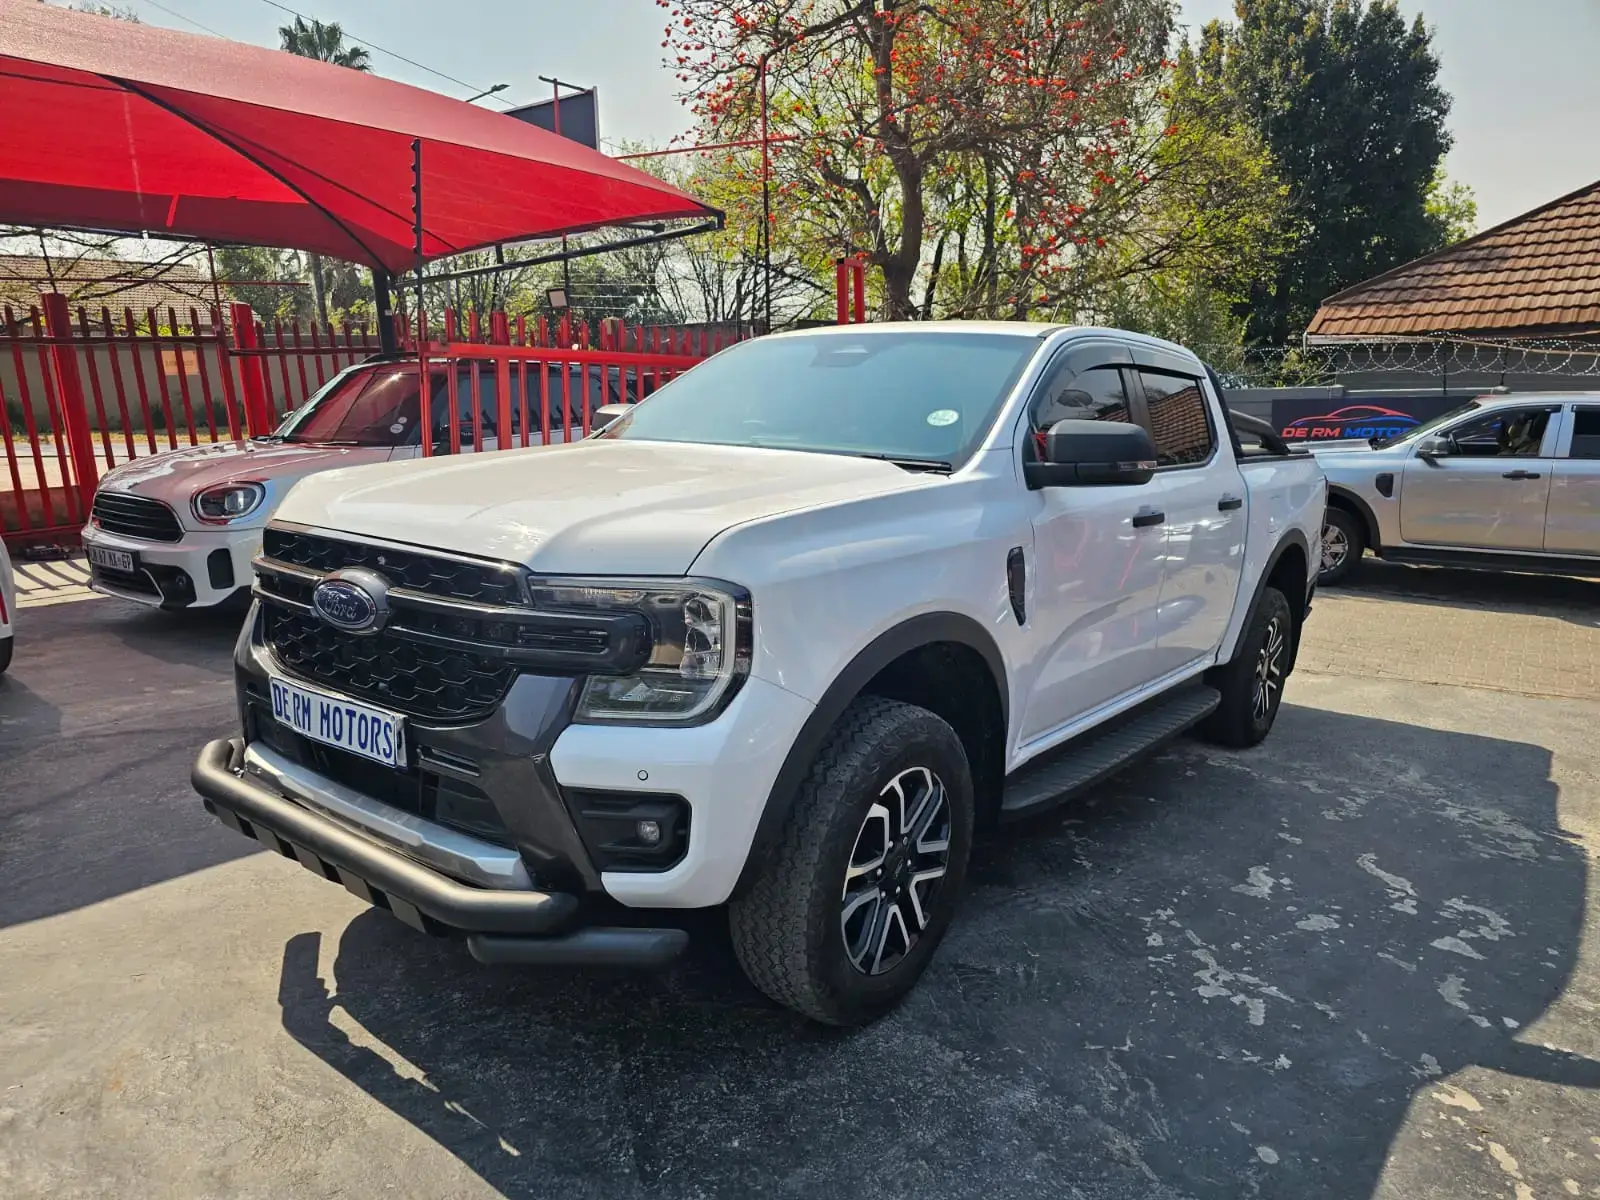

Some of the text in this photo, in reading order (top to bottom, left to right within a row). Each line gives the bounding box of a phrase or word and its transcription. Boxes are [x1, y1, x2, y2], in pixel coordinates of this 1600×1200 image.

[1281, 427, 1308, 438] DE
[1310, 427, 1341, 438] RM
[320, 588, 358, 620] Ford
[320, 701, 393, 759] MOTORS
